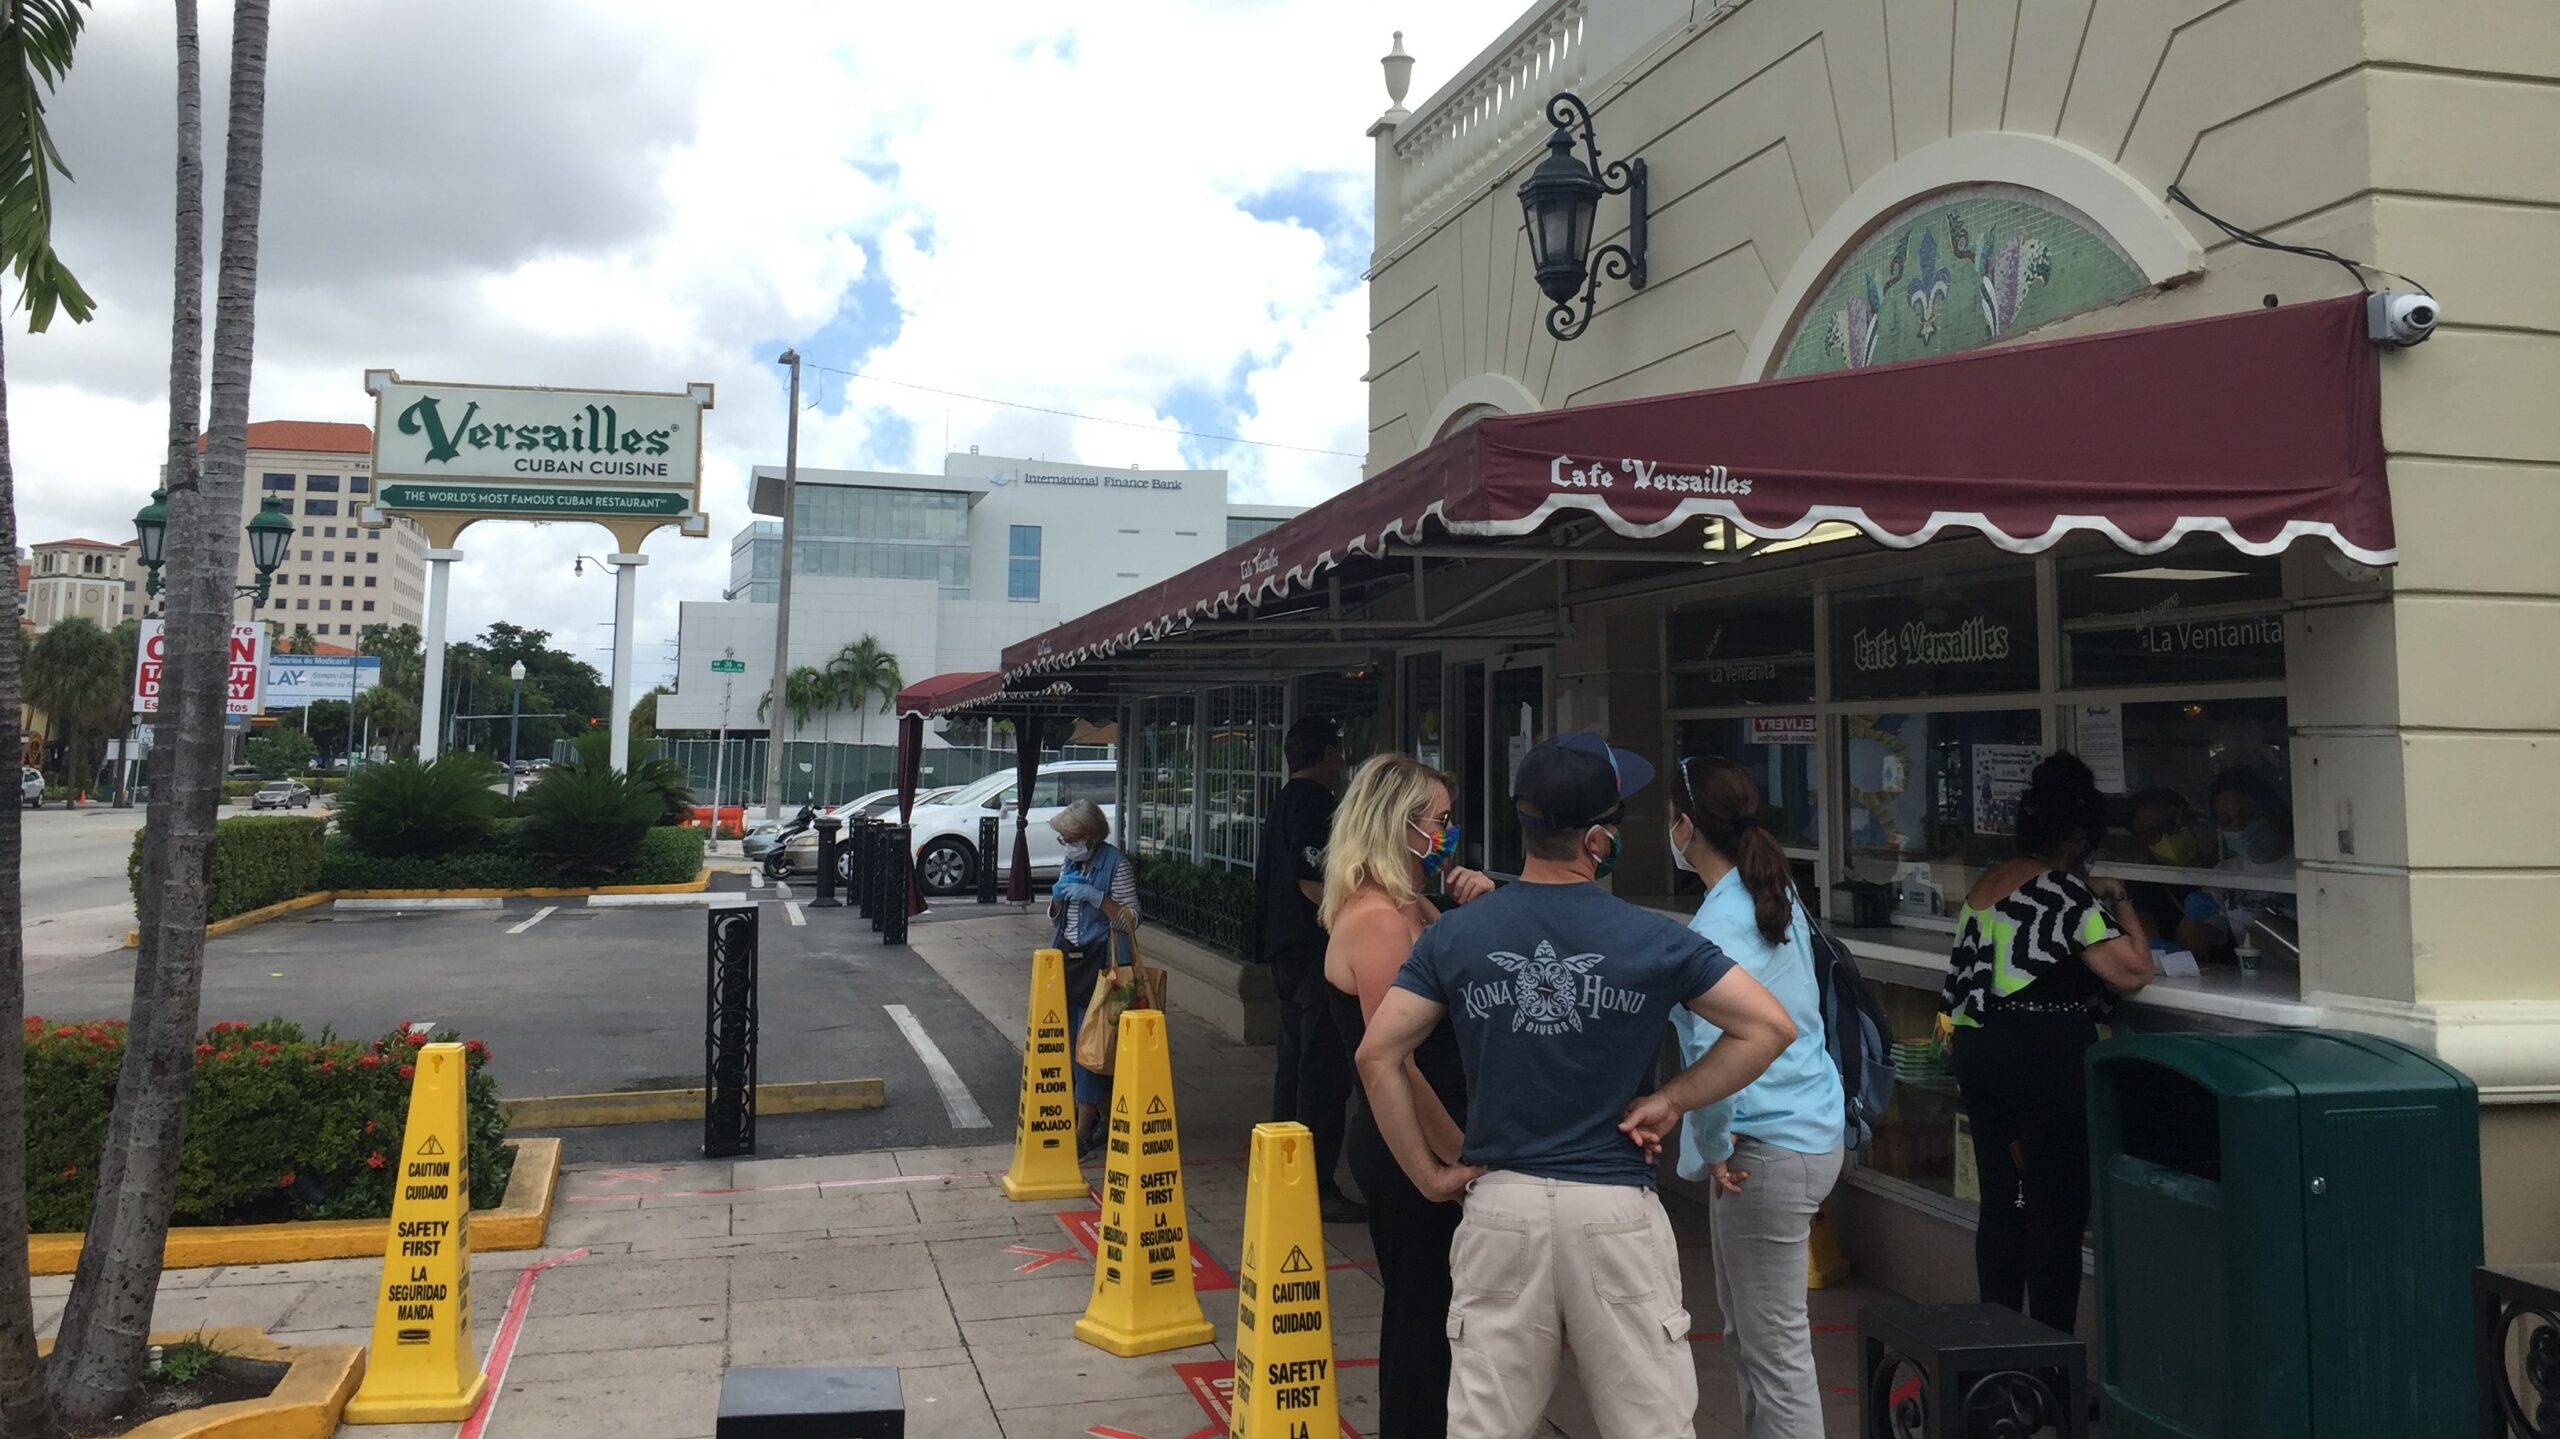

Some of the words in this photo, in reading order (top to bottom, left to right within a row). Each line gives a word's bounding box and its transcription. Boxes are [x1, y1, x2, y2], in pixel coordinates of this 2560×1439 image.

[514, 458, 584, 474] CUBAN
[590, 460, 668, 477] CUISINE
[1551, 454, 1614, 488] Cafe
[1621, 458, 1753, 496] Versailles
[1025, 473, 1099, 487] International
[1104, 476, 1149, 489] Finance
[1152, 479, 1182, 490] Bank
[404, 490, 426, 502] THE
[428, 491, 476, 503] WORLD'S
[479, 492, 509, 504] MOST
[511, 493, 555, 506] FAMOUS
[556, 495, 593, 507] CUBAN
[595, 496, 661, 509] RESTAURANT
[1854, 626, 1897, 671] Cafe
[1900, 615, 2009, 666] Versailles
[2151, 627, 2173, 653] La
[2176, 616, 2283, 651] Ventanita
[1459, 978, 1514, 1019] KONA
[1578, 974, 1646, 1019] HONU
[1038, 1028, 1064, 1038] CAUTION
[1525, 1021, 1570, 1035] DIVERS
[1037, 1043, 1064, 1053] CUIDADO
[1040, 1067, 1062, 1078] WET
[1035, 1082, 1067, 1093] FLOOR
[1040, 1105, 1062, 1117] PISO
[1031, 1120, 1072, 1132] MOJADO
[1142, 1118, 1172, 1135] CAUTION
[1142, 1139, 1173, 1156] CUIDADO
[408, 1161, 450, 1178] CAUTION
[1140, 1170, 1177, 1189] SAFETY
[405, 1184, 448, 1201] CUIDADO
[1145, 1188, 1173, 1206] FIRST
[1155, 1212, 1167, 1227] LA
[398, 1220, 449, 1239] SAFETY
[1140, 1227, 1183, 1247] SEGURIDAD
[402, 1240, 441, 1257] FIRST
[1149, 1246, 1175, 1264] MANDA
[411, 1266, 427, 1282] LA
[388, 1284, 447, 1302] SEGURIDAD
[1273, 1280, 1320, 1304] CAUTION
[398, 1304, 434, 1321] MANDA
[1273, 1310, 1322, 1335] CUIDADO
[1269, 1359, 1328, 1385] SAFETY
[1276, 1386, 1321, 1410] FIRST
[1290, 1421, 1310, 1439] LA
